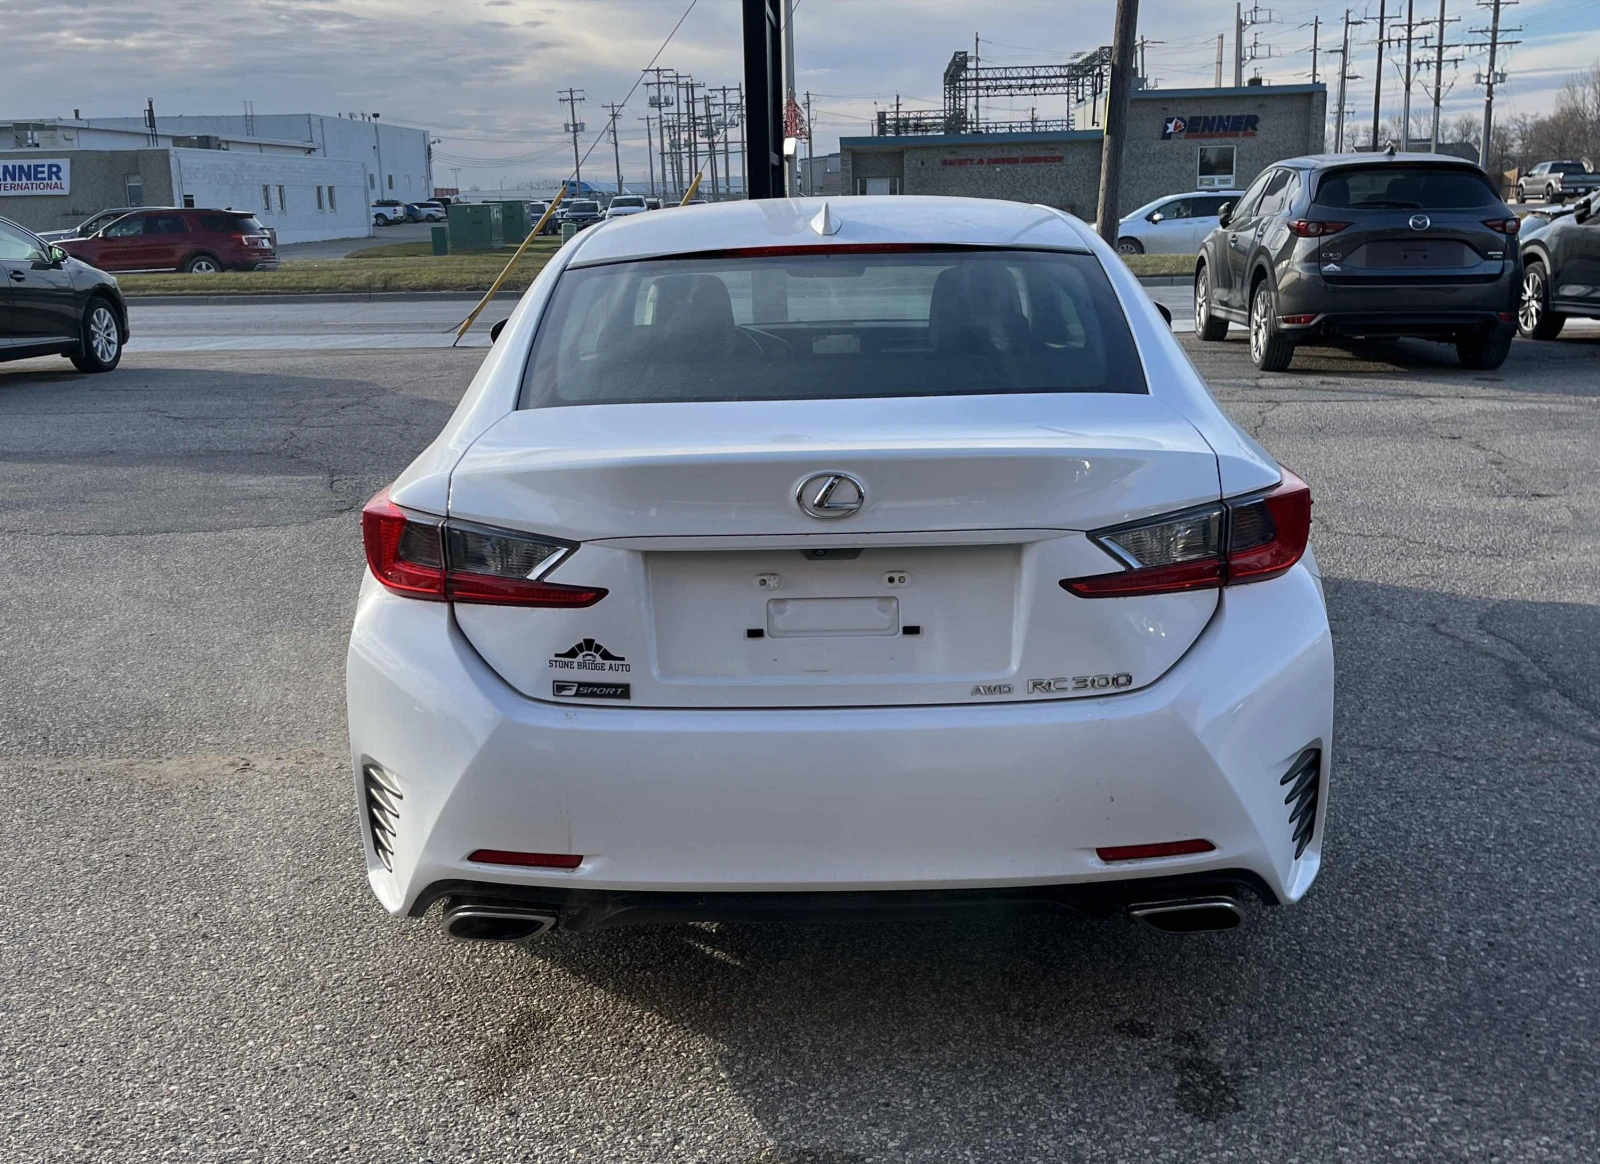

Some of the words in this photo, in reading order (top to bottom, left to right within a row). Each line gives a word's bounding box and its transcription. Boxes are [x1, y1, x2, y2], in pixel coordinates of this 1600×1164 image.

[1161, 115, 1259, 140] PENNER
[0, 164, 62, 181] NNER
[548, 660, 575, 669] STONE
[577, 661, 606, 671] BRIDGE
[608, 663, 631, 672] AUTO
[578, 687, 625, 695] SPORT
[971, 684, 1014, 696] AWD
[1027, 678, 1068, 694] RC
[1072, 672, 1133, 691] 300
